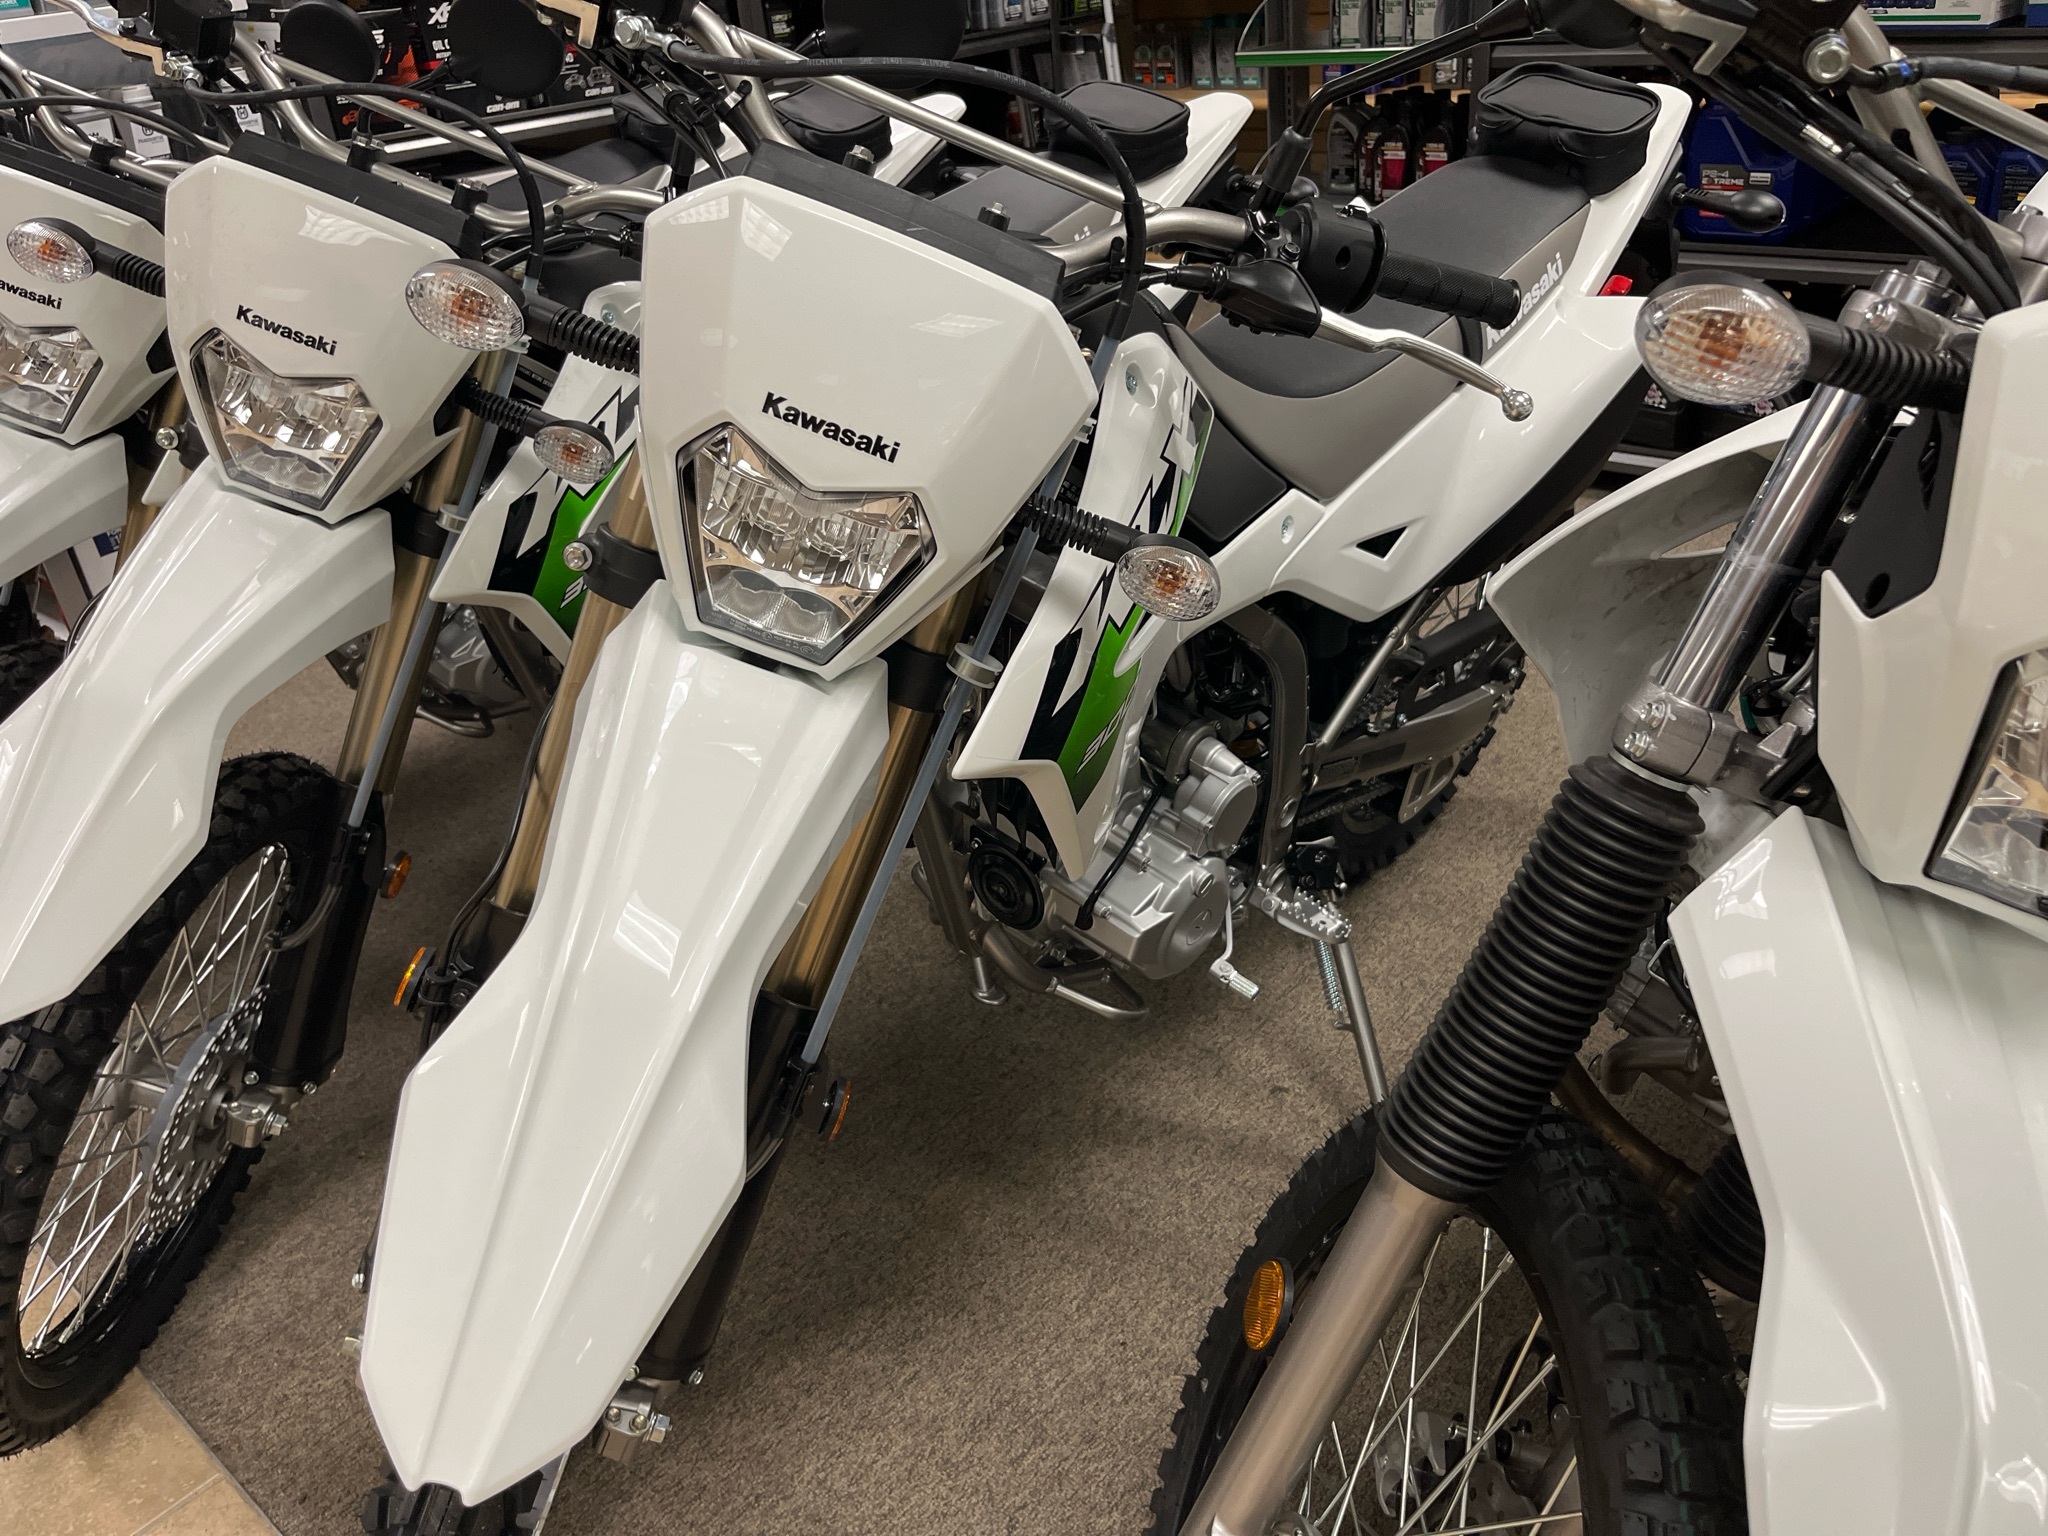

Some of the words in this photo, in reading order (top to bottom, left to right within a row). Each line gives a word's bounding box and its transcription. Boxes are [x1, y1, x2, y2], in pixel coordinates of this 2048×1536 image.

[0, 278, 62, 310] awasaki
[1486, 251, 1563, 351] Kasaki
[235, 304, 338, 357] Kawasaki
[761, 391, 901, 464] Kawasaki
